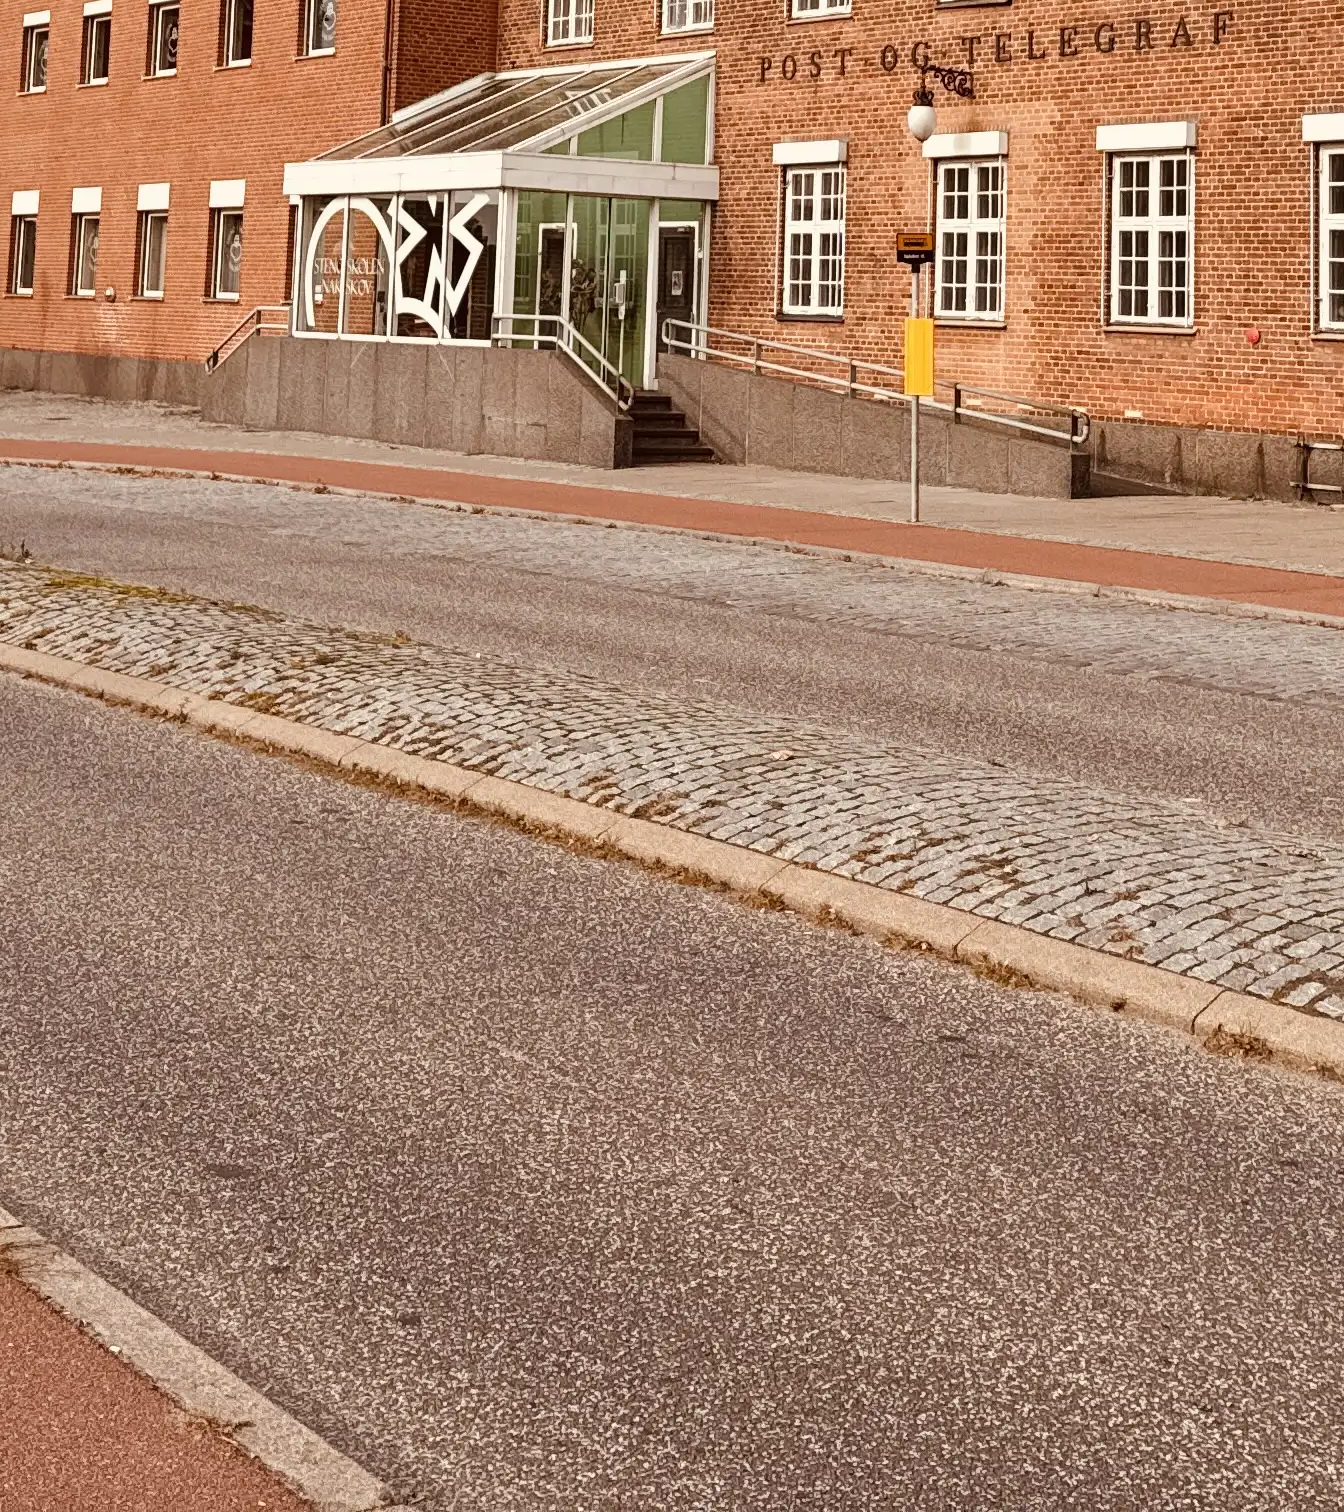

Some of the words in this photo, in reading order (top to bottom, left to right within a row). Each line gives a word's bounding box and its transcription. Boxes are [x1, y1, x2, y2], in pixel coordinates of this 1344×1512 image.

[759, 48, 853, 83] POST
[880, 41, 930, 73] OG
[961, 10, 1235, 66] TELEGRAF
